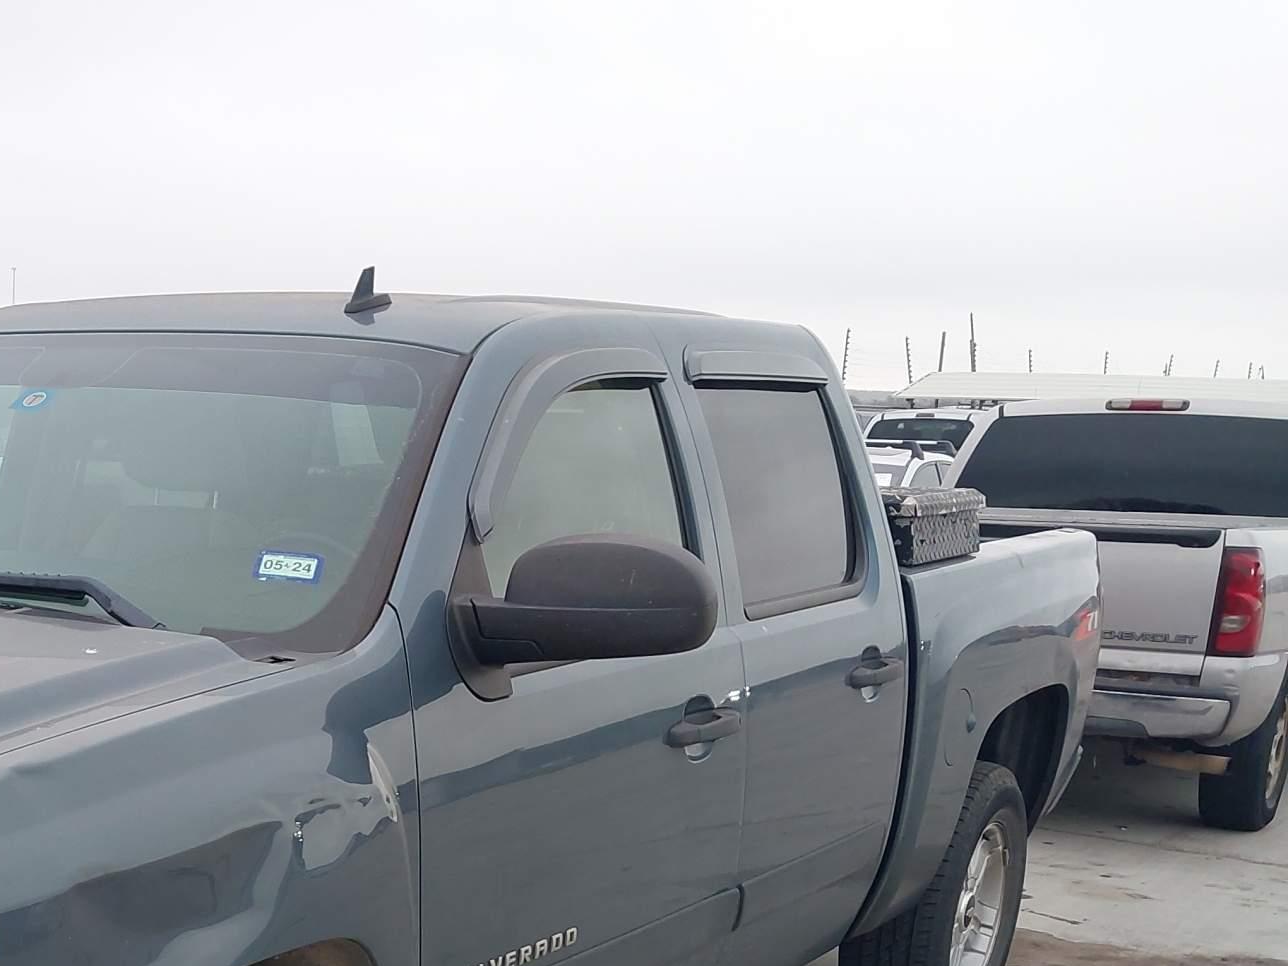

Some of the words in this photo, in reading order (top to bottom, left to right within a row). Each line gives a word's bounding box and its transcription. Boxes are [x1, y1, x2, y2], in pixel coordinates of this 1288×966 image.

[263, 559, 284, 571] 05
[291, 561, 312, 573] 24
[1102, 629, 1199, 644] CHEVROLET
